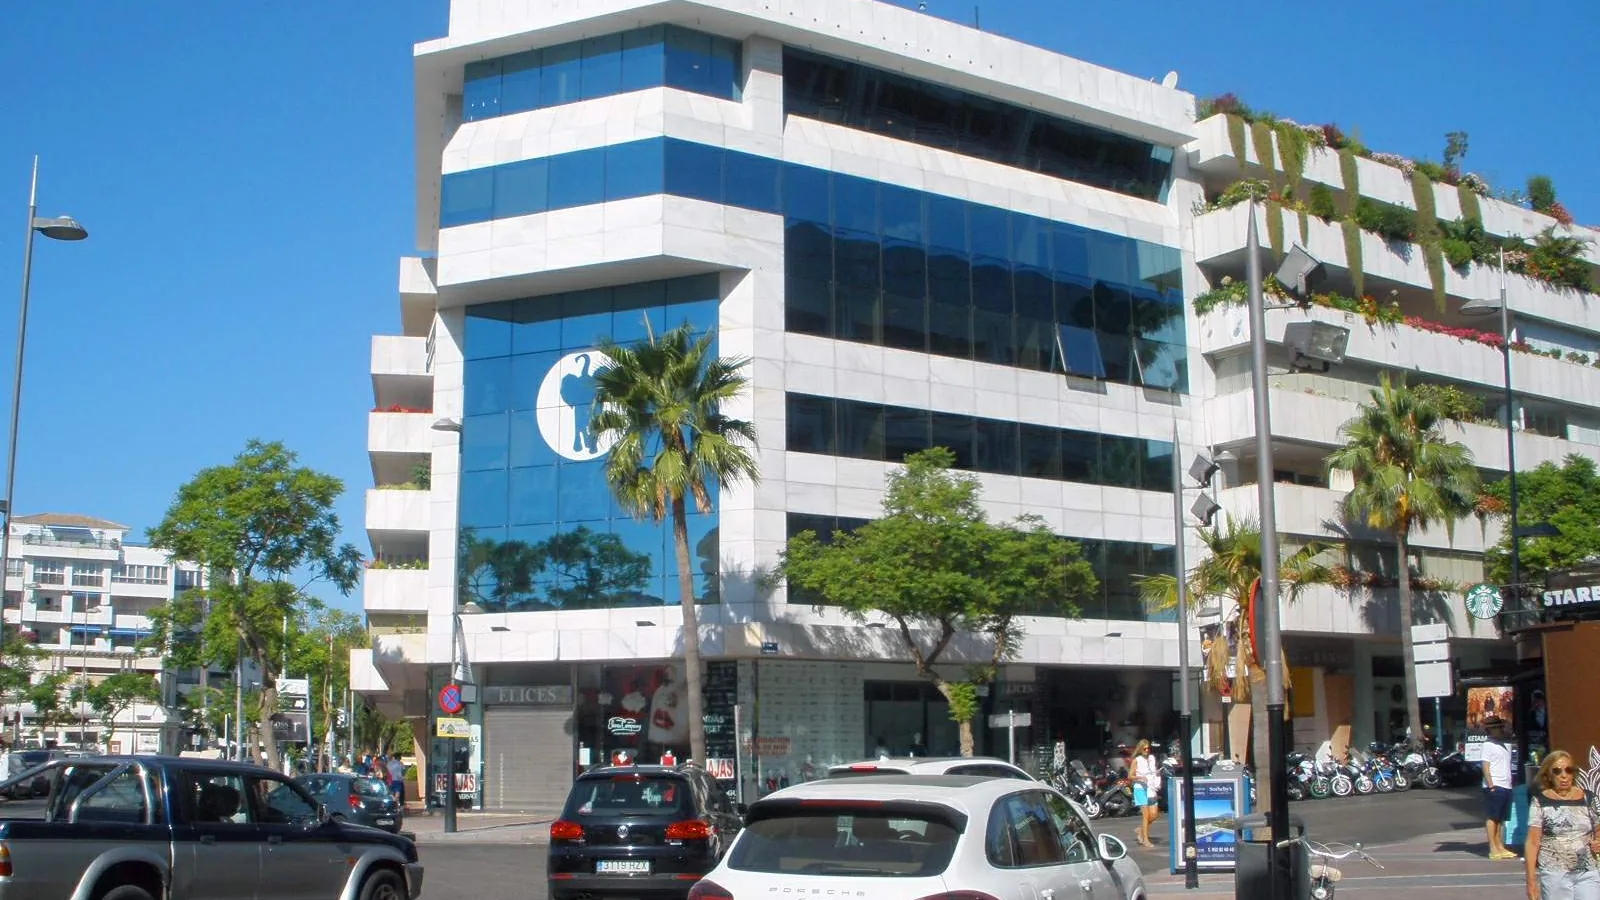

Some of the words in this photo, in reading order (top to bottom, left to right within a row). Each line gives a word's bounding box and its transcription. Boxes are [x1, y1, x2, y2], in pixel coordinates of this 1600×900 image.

[500, 687, 557, 702] ELICES
[436, 774, 475, 791] REAJAS
[769, 887, 865, 897] PORSCHE
